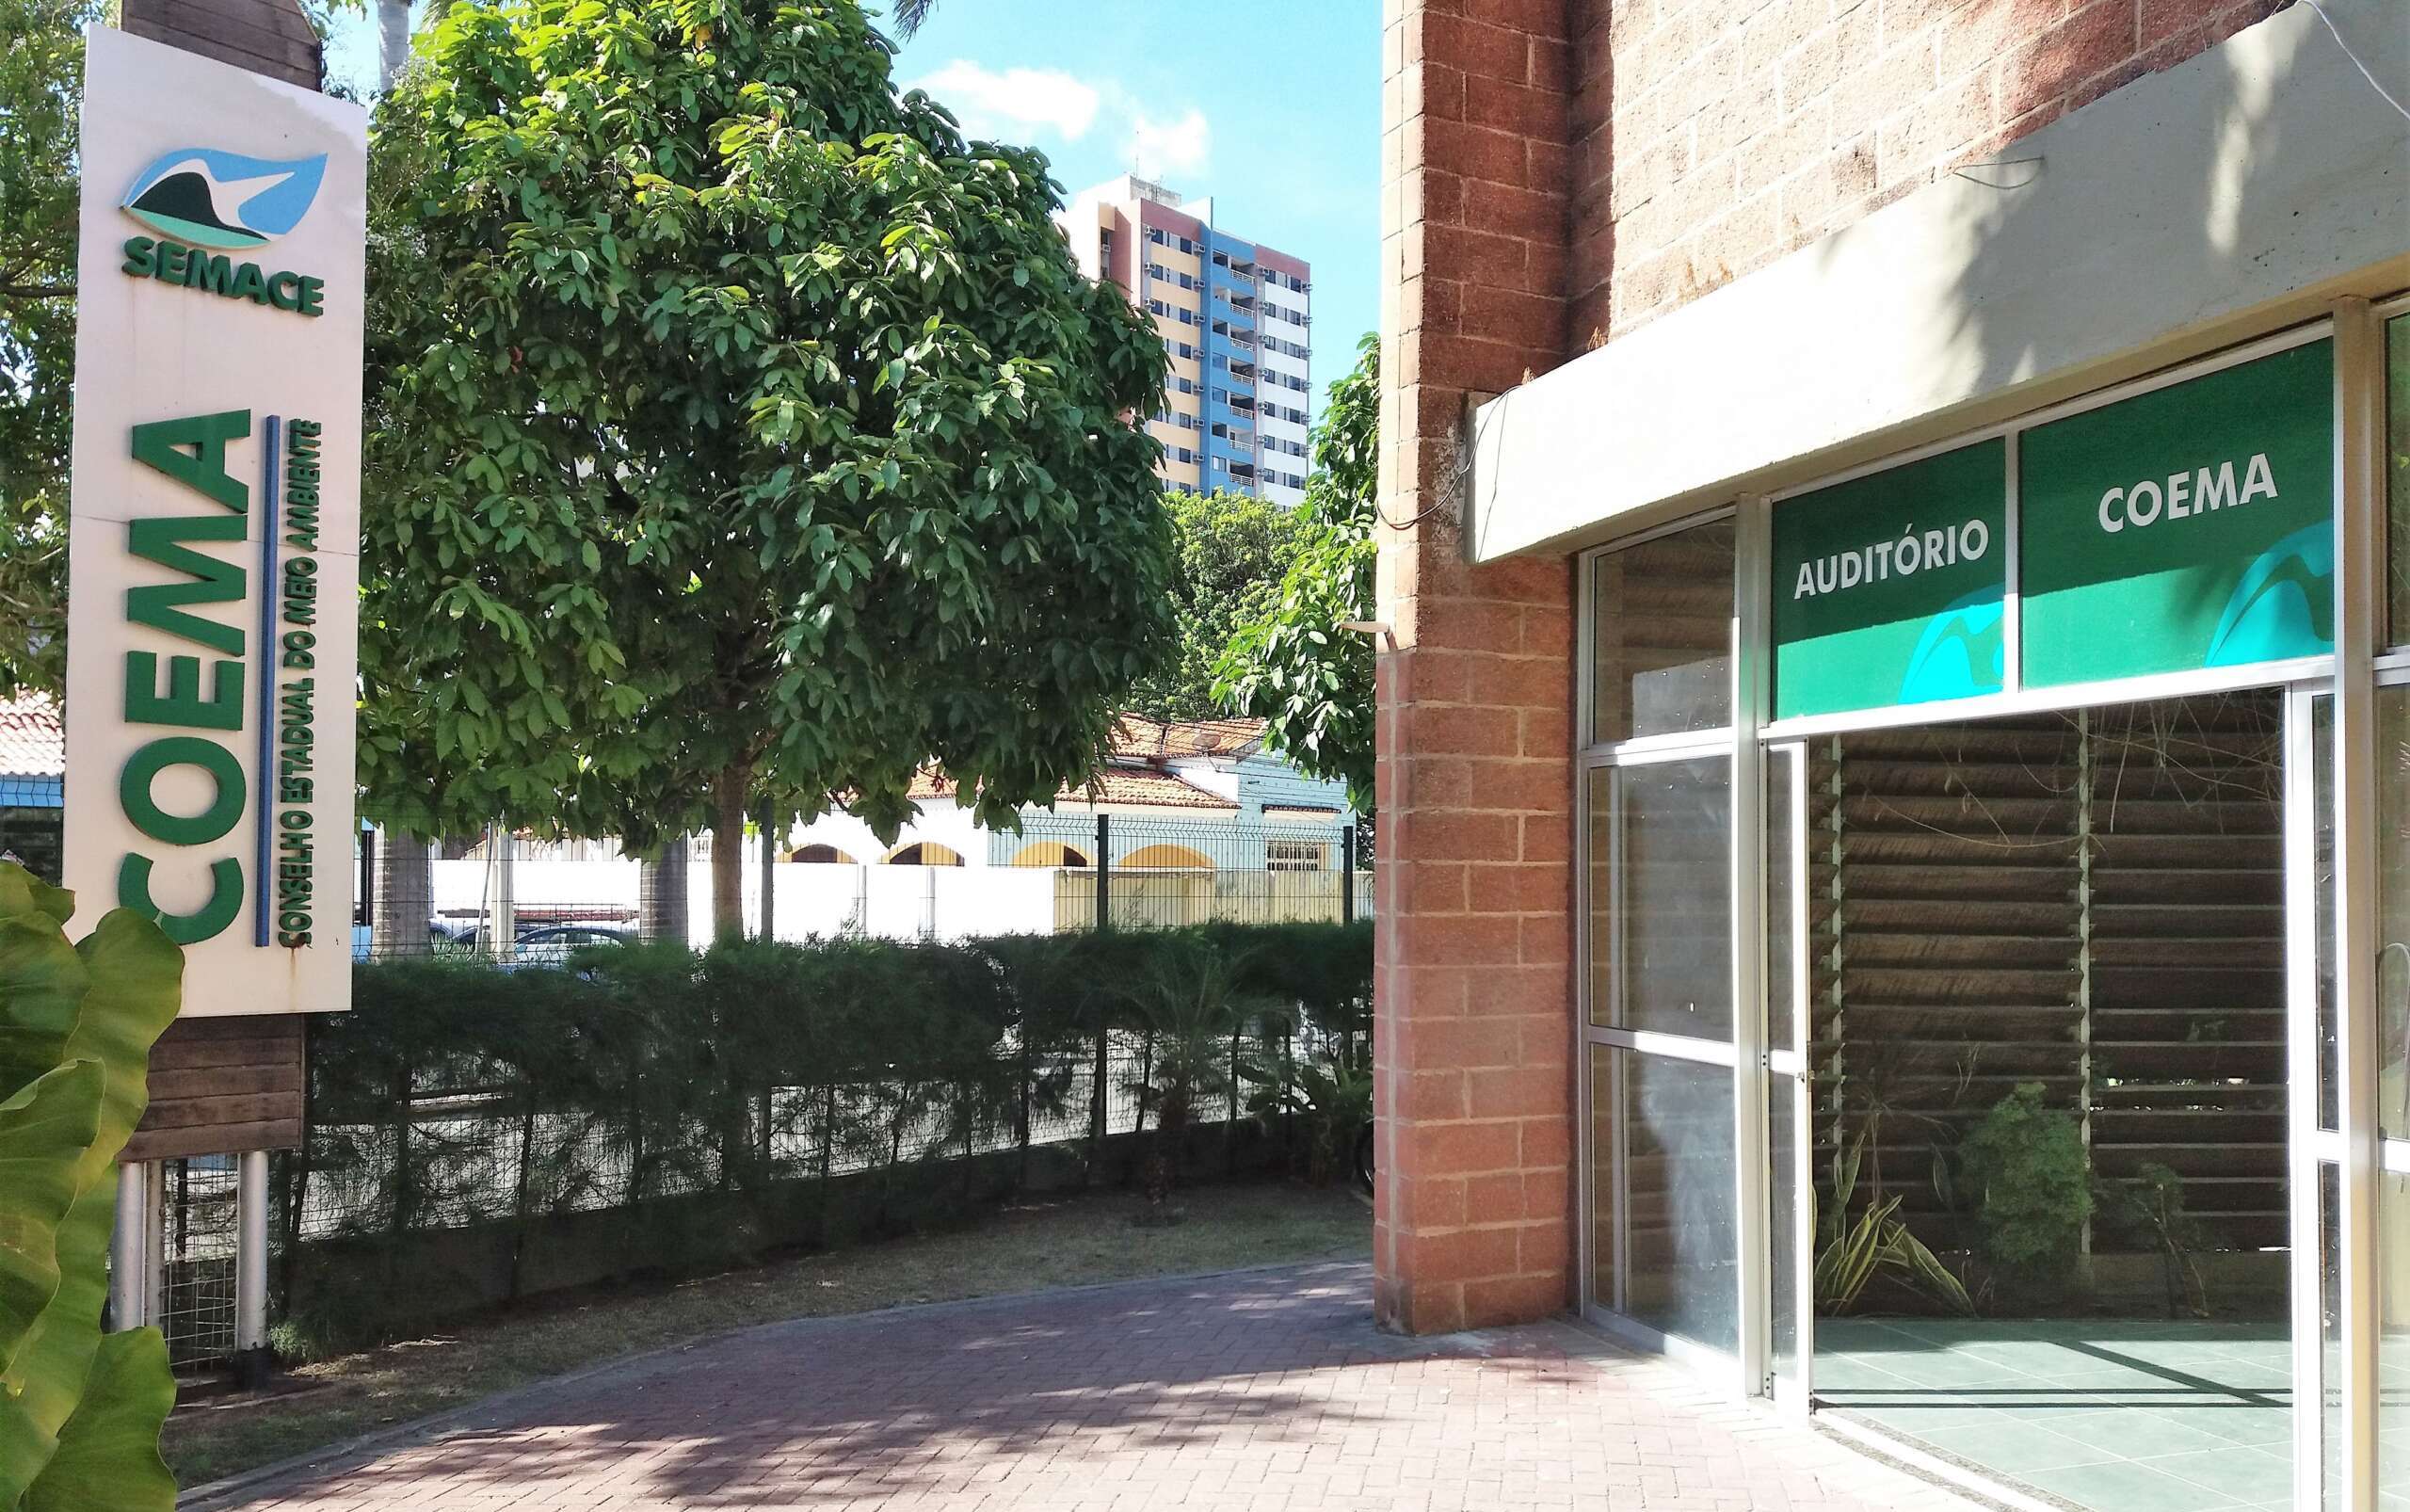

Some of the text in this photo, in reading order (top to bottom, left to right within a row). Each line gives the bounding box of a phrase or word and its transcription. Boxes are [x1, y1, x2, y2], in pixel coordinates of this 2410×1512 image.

[121, 235, 325, 317] SEMACE
[118, 409, 251, 945] COEMA
[278, 418, 322, 949] CONSELHO ESTADUAL DO MEIO AMBIENTE
[1793, 453, 2279, 600] AUDITÓRIO COEMA
